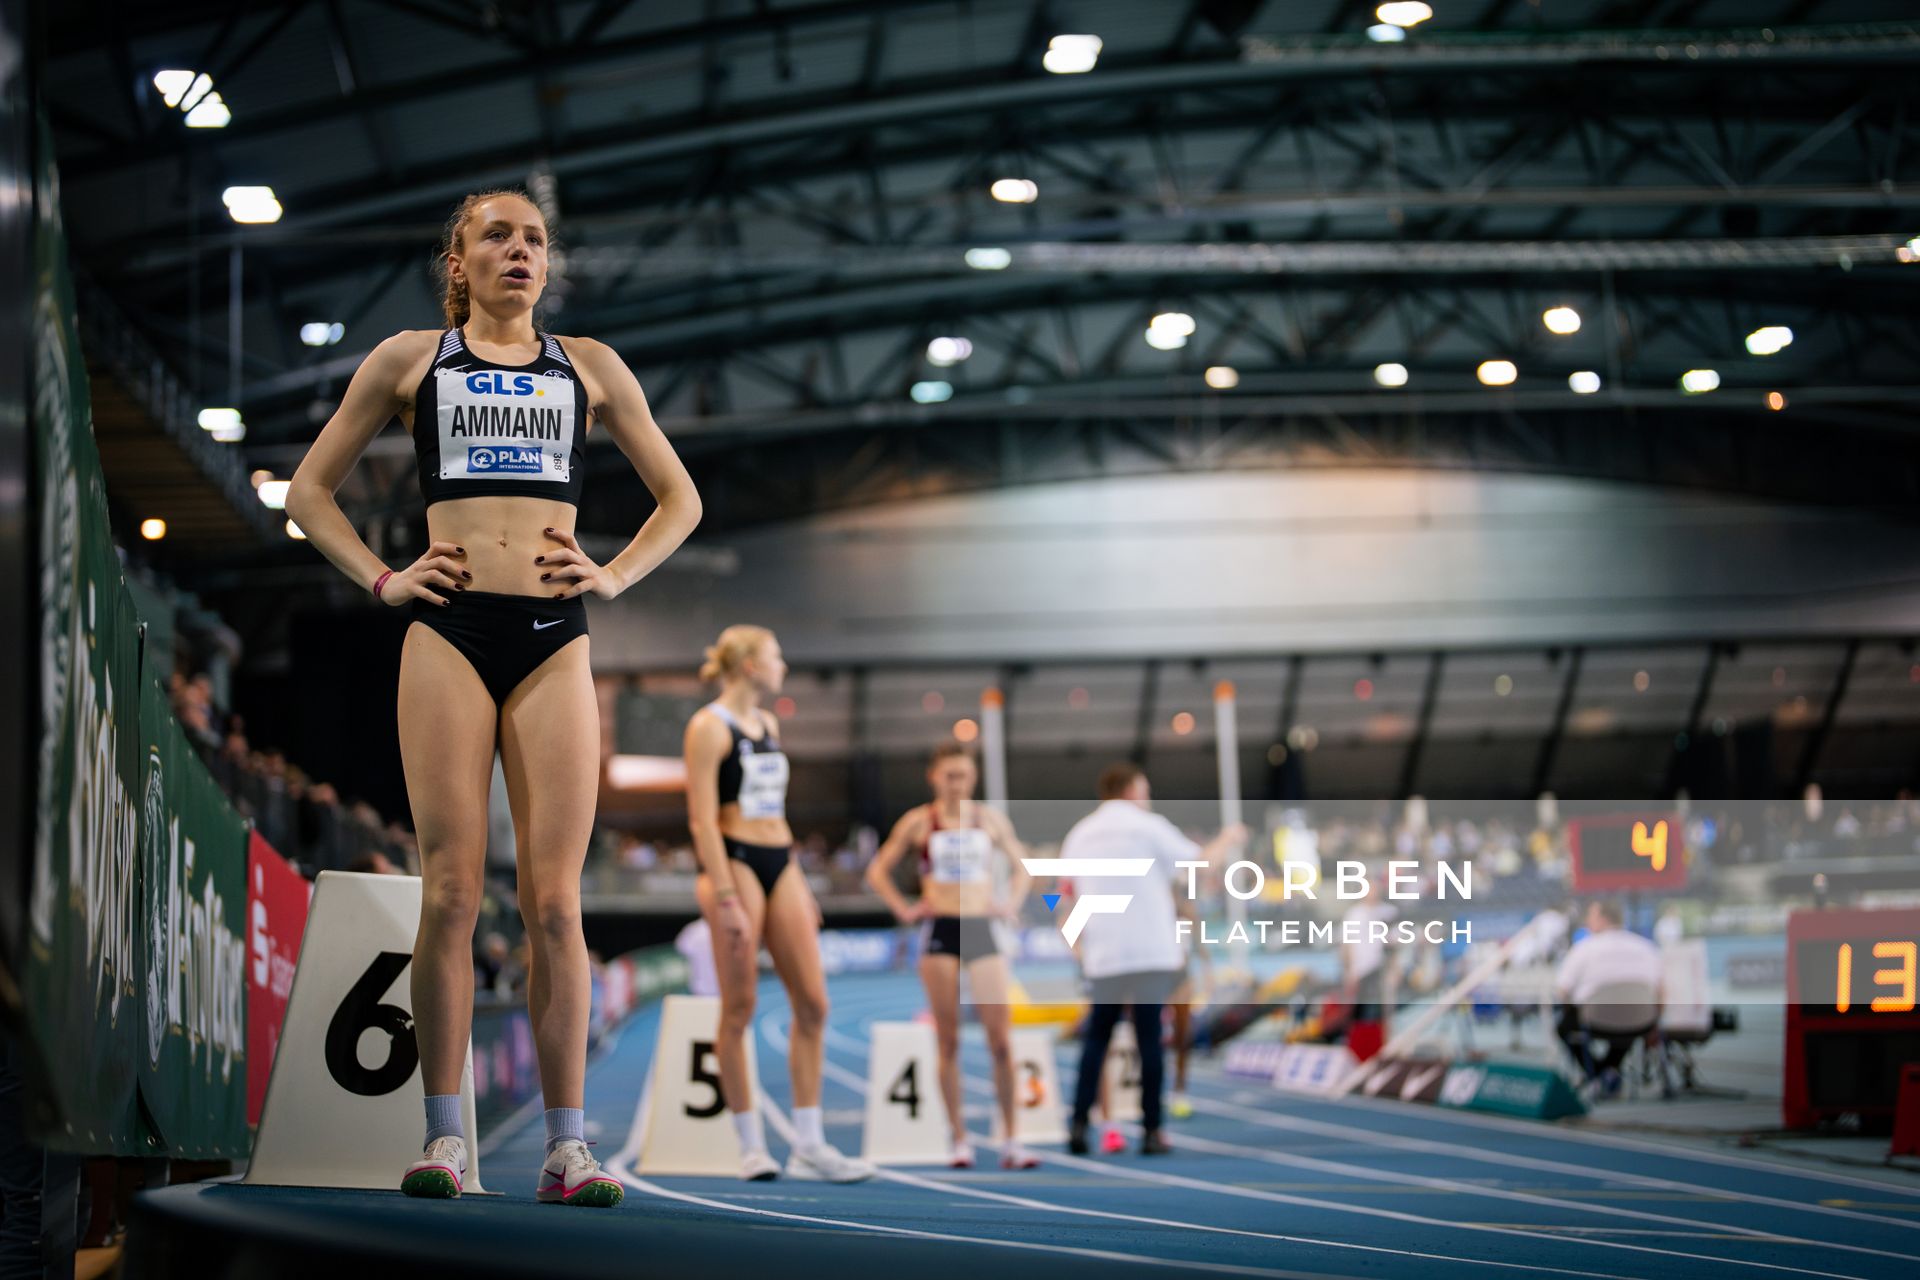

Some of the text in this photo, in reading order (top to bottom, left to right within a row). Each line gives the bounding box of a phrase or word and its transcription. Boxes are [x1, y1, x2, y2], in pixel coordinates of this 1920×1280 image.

[451, 405, 562, 441] AMMANN
[499, 451, 539, 464] PLAN
[553, 452, 563, 471] 368
[1632, 820, 1669, 871] 4
[1836, 941, 1918, 1014] 13
[325, 951, 420, 1096] 6
[684, 1040, 729, 1119] 5
[888, 1058, 921, 1119] 4
[1021, 1059, 1046, 1108] 3
